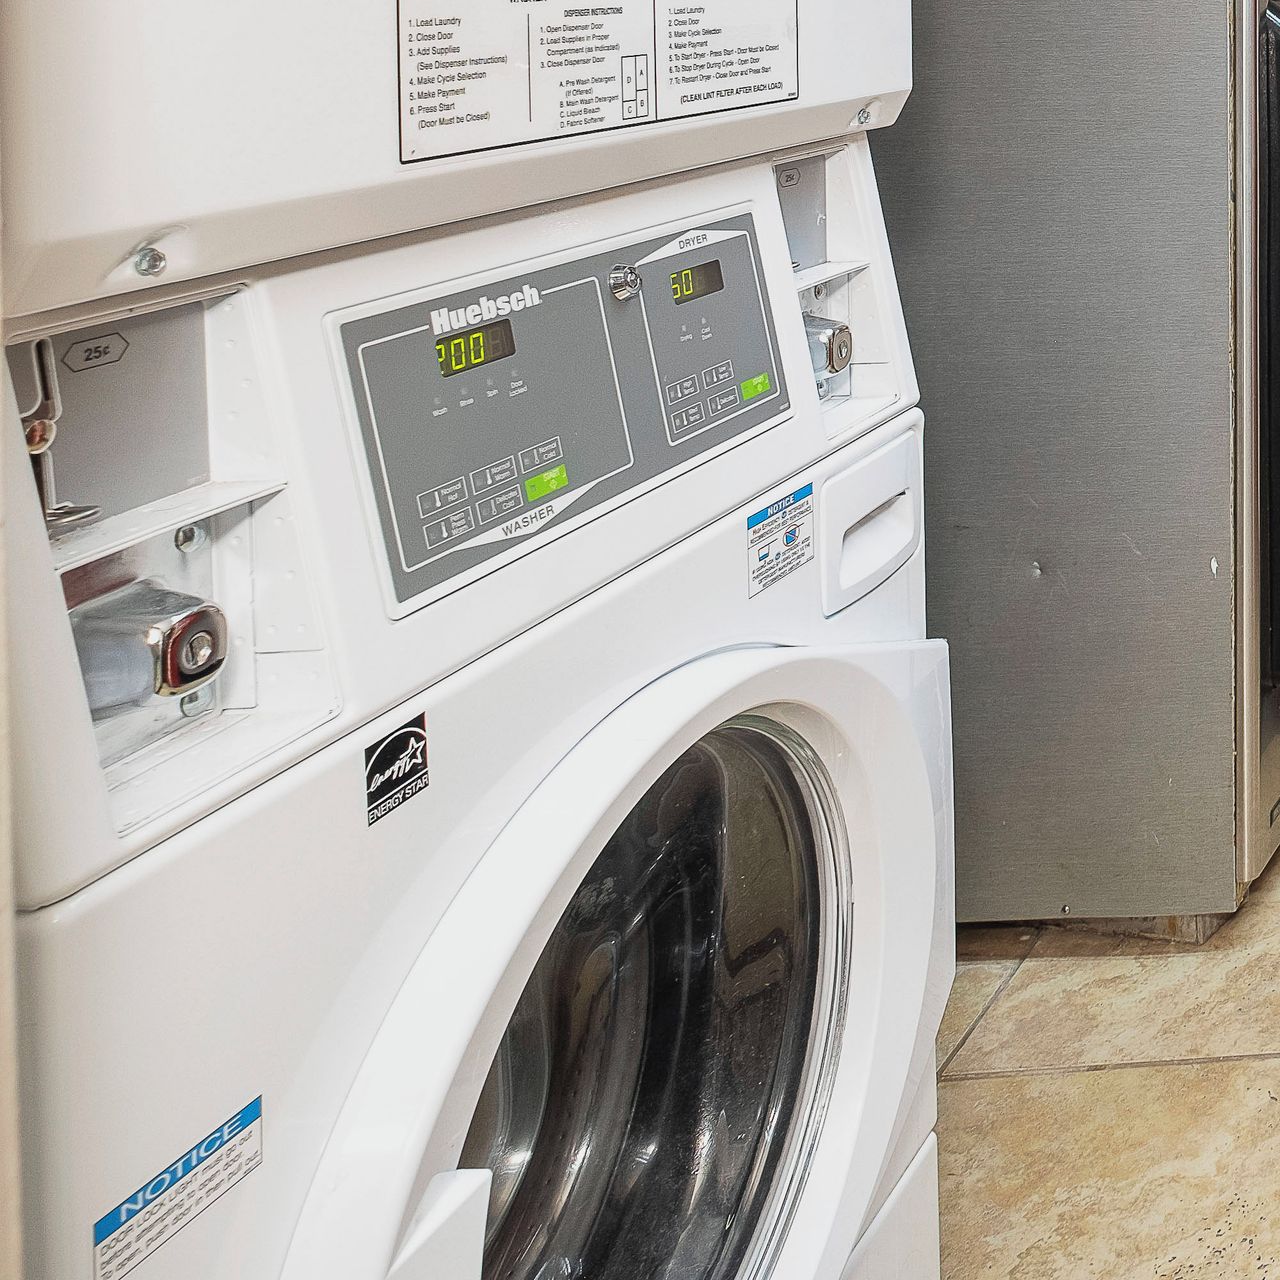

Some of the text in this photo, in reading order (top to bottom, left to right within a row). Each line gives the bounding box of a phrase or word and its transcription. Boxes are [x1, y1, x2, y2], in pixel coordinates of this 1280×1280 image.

[564, 7, 623, 17] DISPENSER INSTRUCTIONS
[416, 18, 433, 27] Load
[434, 17, 461, 26] Laundry
[416, 32, 435, 41] Close
[437, 31, 453, 40] Door
[416, 47, 430, 56] Add
[431, 45, 460, 56] Supplies
[417, 55, 507, 72] (See Dispenser Instructions)
[417, 75, 435, 85] Make
[437, 74, 455, 85] Cycle
[457, 70, 487, 81] Selection
[417, 90, 435, 100] Make
[437, 87, 466, 98] Payment
[680, 81, 783, 104] (CLEAN LINT FILTER AFTER EACH LOAD)
[418, 111, 491, 130] (Door Must be Closed)
[678, 233, 708, 250] DRYER
[430, 284, 541, 336] Huebsch
[84, 346, 112, 362] 25¢
[538, 441, 557, 454] Normal
[543, 450, 557, 461] Cold
[490, 460, 512, 475] Normal
[440, 481, 463, 497] Normal
[767, 493, 795, 518] NOTICE
[502, 505, 556, 538] WASHER
[368, 774, 429, 824] ENERGY STAR
[119, 1114, 244, 1223] NOTICE
[100, 1224, 135, 1257] DOOR
[136, 1198, 168, 1229] LOCK
[169, 1172, 200, 1202] LIGHT
[201, 1154, 224, 1176] must
